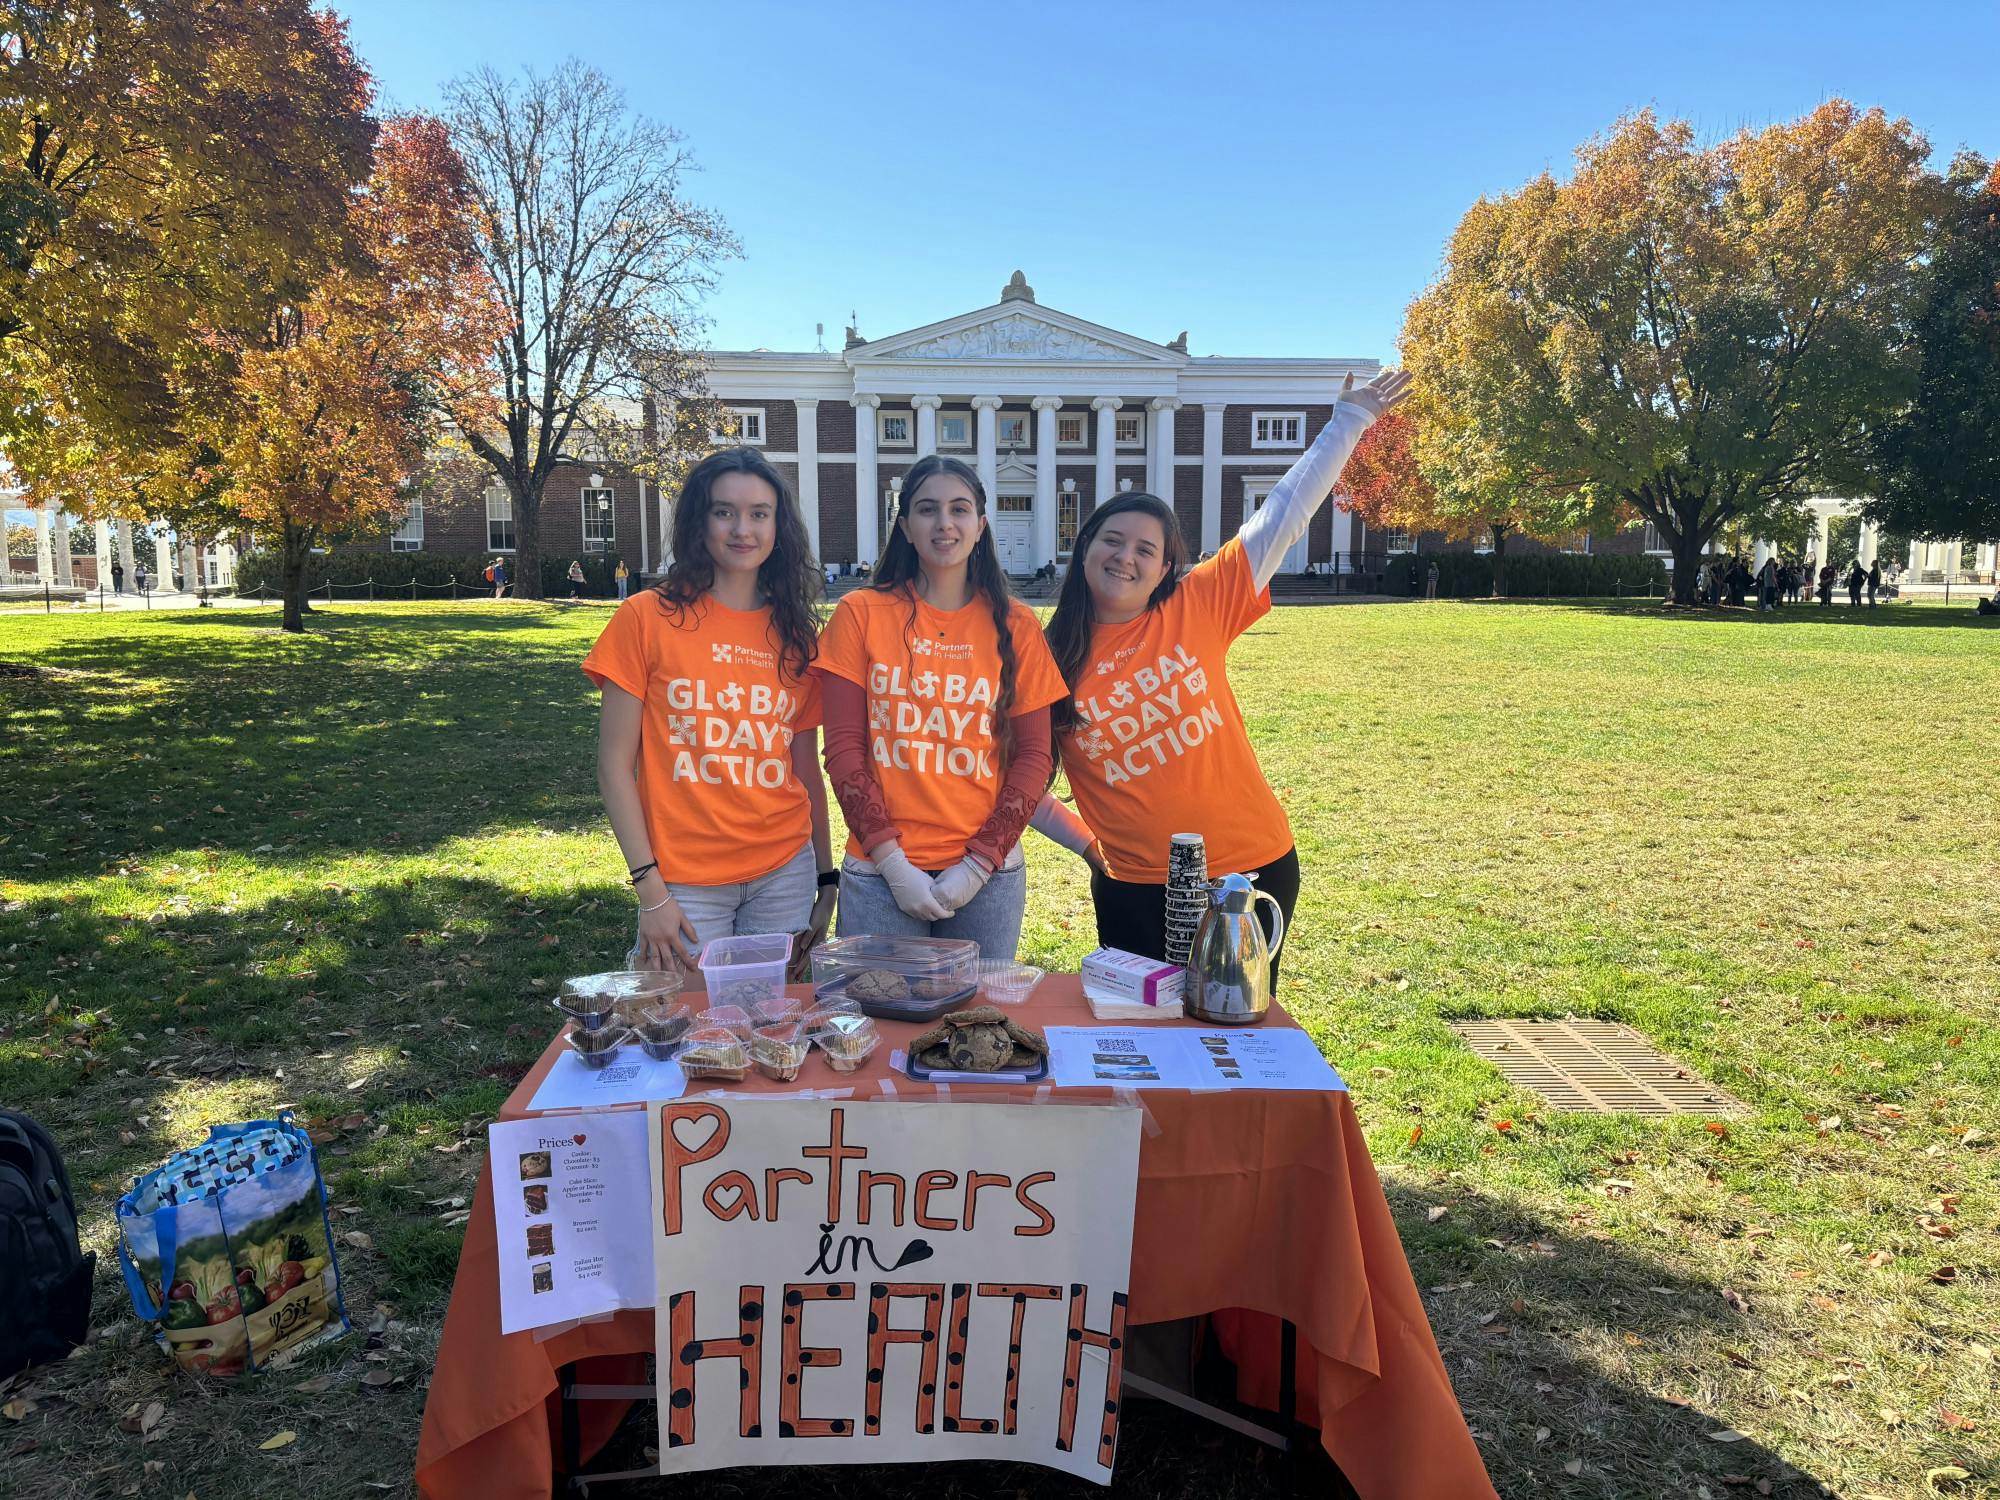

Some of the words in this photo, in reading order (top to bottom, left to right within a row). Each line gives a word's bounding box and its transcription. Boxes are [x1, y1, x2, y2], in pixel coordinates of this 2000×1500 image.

[735, 645, 774, 659] Partners
[746, 657, 774, 669] Health
[934, 642, 974, 652] Partners
[944, 651, 974, 660] Health
[896, 702, 975, 740] DAY
[1109, 684, 1182, 744] DAY
[705, 716, 779, 752] DAY
[1103, 699, 1224, 787] ACTION
[671, 751, 792, 789] ACTIO
[538, 1137, 574, 1149] Prices
[661, 1103, 1055, 1236] Partners
[805, 1224, 920, 1276] in
[669, 1283, 1127, 1469] HEALTH
